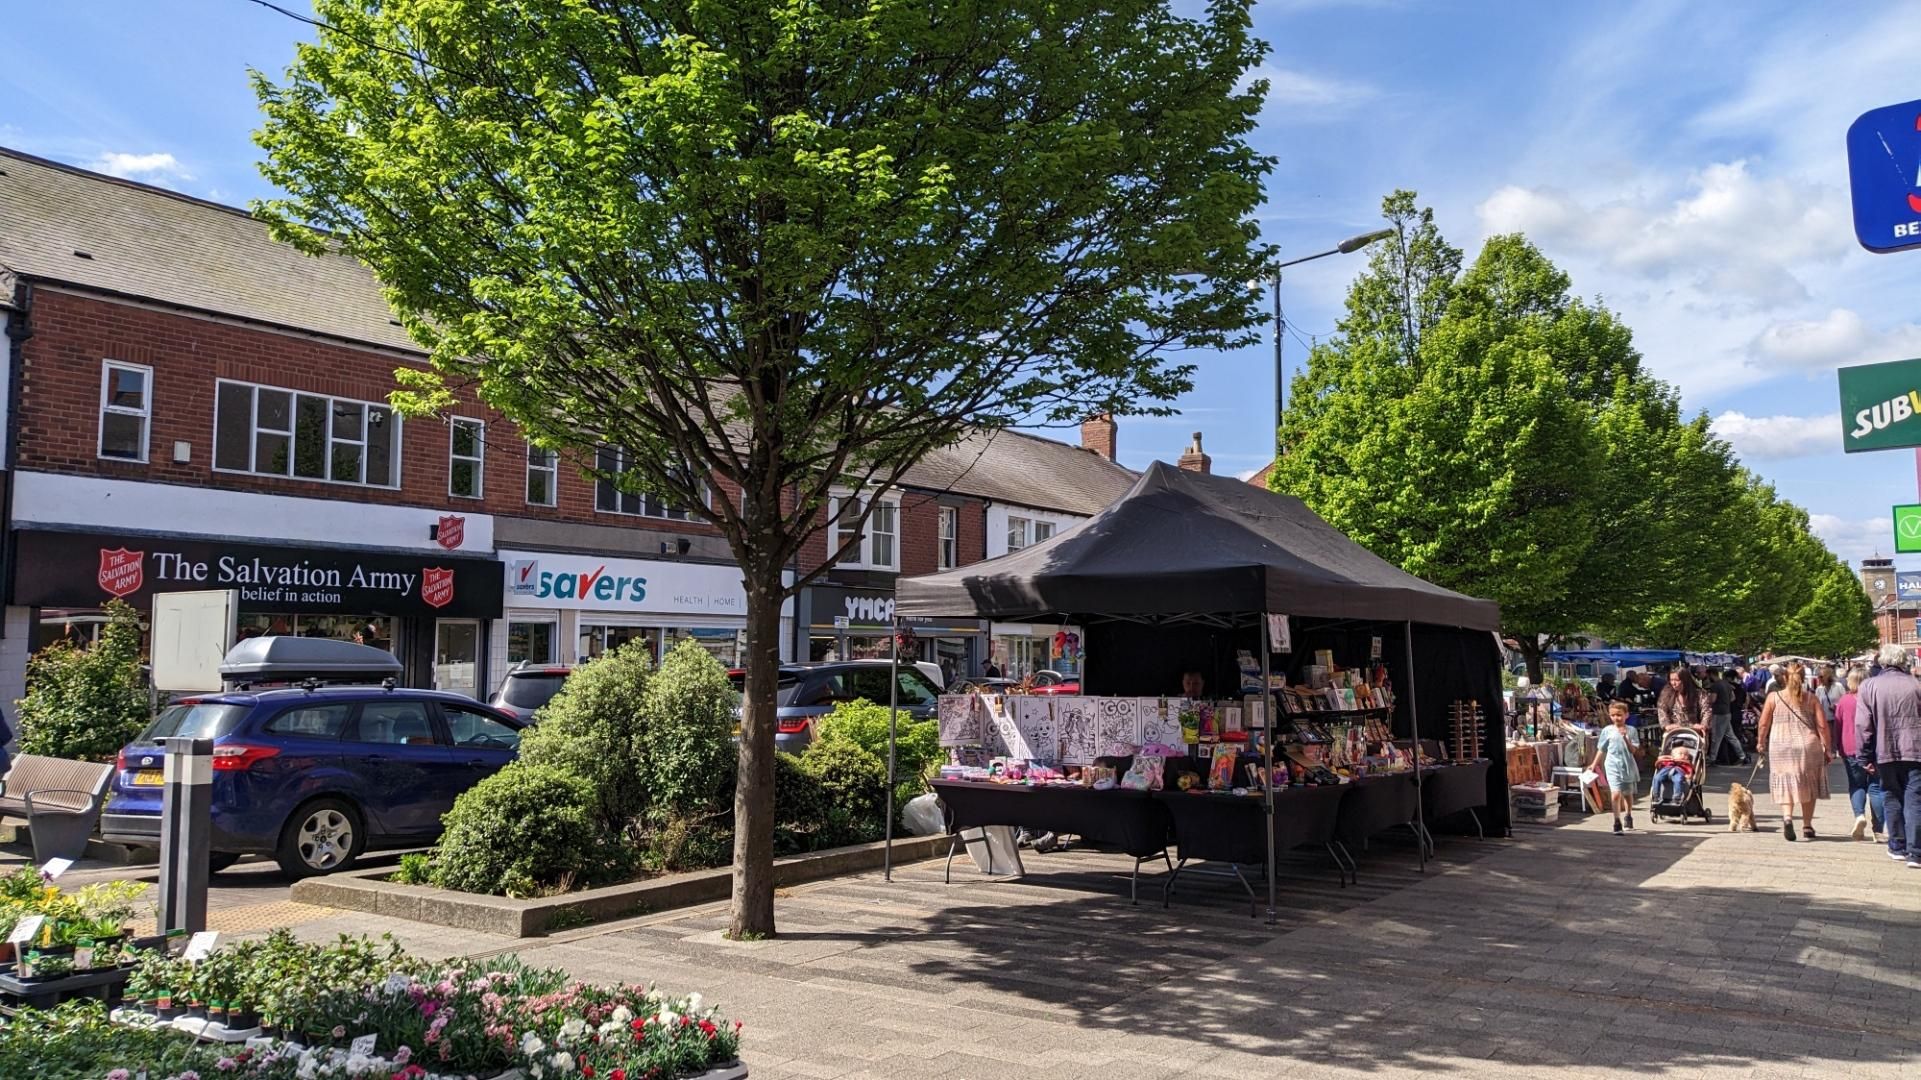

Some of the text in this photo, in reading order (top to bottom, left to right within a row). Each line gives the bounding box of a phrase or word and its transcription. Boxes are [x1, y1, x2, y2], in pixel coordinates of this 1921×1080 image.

[1894, 220, 1921, 238] BE
[445, 532, 460, 545] ARMY
[110, 554, 126, 567] THE
[101, 558, 141, 583] SALVATION
[152, 551, 416, 597] The Salvation Army
[429, 571, 441, 583] THE
[114, 571, 138, 591] ARMY
[423, 576, 452, 596] SALVATION
[535, 565, 647, 602] savers
[241, 586, 341, 604] belief in action
[433, 587, 450, 602] ARMY
[673, 596, 735, 607] HEALTH HOME
[845, 596, 895, 621] YMCA
[1103, 699, 1130, 715] GO
